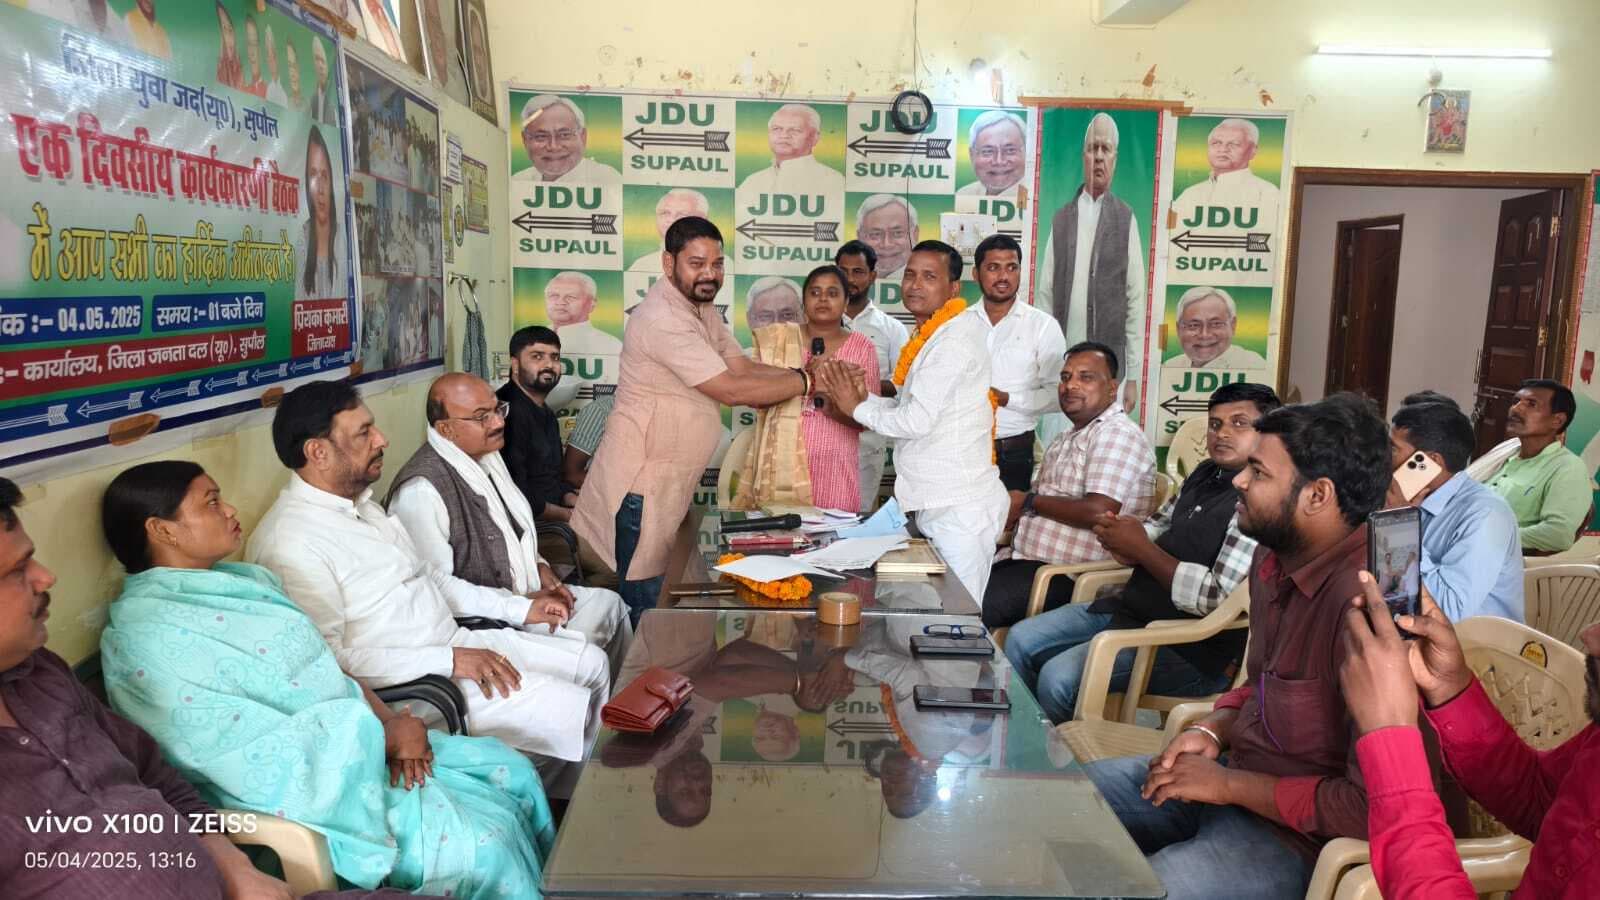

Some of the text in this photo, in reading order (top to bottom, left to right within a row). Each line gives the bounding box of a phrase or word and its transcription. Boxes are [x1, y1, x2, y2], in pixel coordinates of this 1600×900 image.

[128, 66, 168, 108] युवा
[635, 102, 715, 126] JDU
[9, 112, 72, 180] एक
[76, 112, 174, 197] दिवसीय
[631, 155, 729, 172] SUPAUL
[854, 162, 950, 179] SUPAUL
[523, 186, 602, 210] JDU
[747, 194, 825, 217] JDU
[1183, 206, 1259, 228] JDU
[27, 202, 52, 280] में
[57, 228, 106, 281] आप
[109, 213, 149, 281] सभी
[151, 234, 177, 281] का
[180, 220, 228, 287] हार्दिक
[519, 238, 617, 255] SUPAUL
[742, 245, 837, 262] SUPAUL
[1175, 257, 1268, 272] SUPAUL
[57, 305, 141, 332] 04.05.2025
[157, 305, 192, 326] समय
[208, 302, 219, 321] 01
[221, 299, 242, 320] बजे
[244, 296, 264, 319] दिन
[23, 349, 103, 381] कार्यालय,
[107, 345, 146, 370] जिला
[148, 342, 186, 364] जनता
[188, 341, 208, 361] दल
